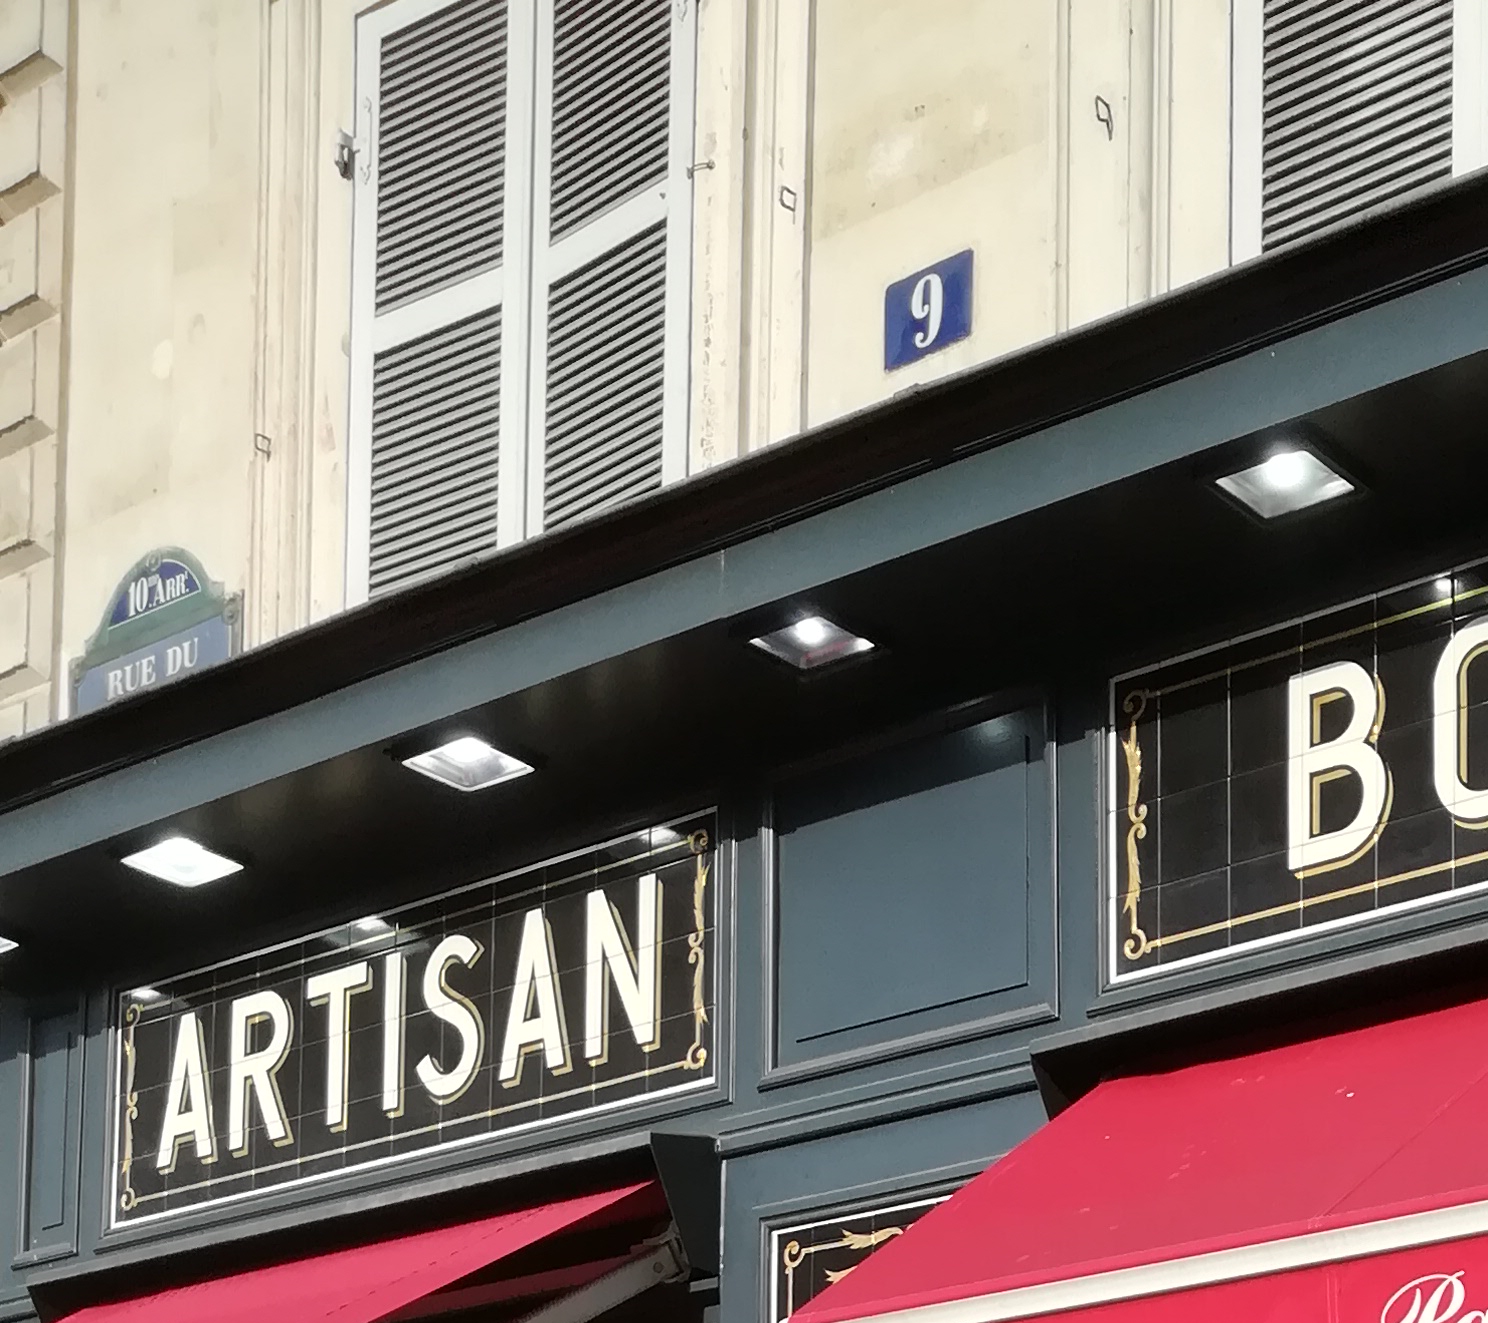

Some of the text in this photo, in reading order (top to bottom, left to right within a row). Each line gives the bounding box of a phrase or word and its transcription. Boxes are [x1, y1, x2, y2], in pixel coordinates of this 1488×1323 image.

[911, 273, 943, 349] 9
[107, 638, 198, 701] RUE DU
[156, 873, 664, 1174] ARTISAN
